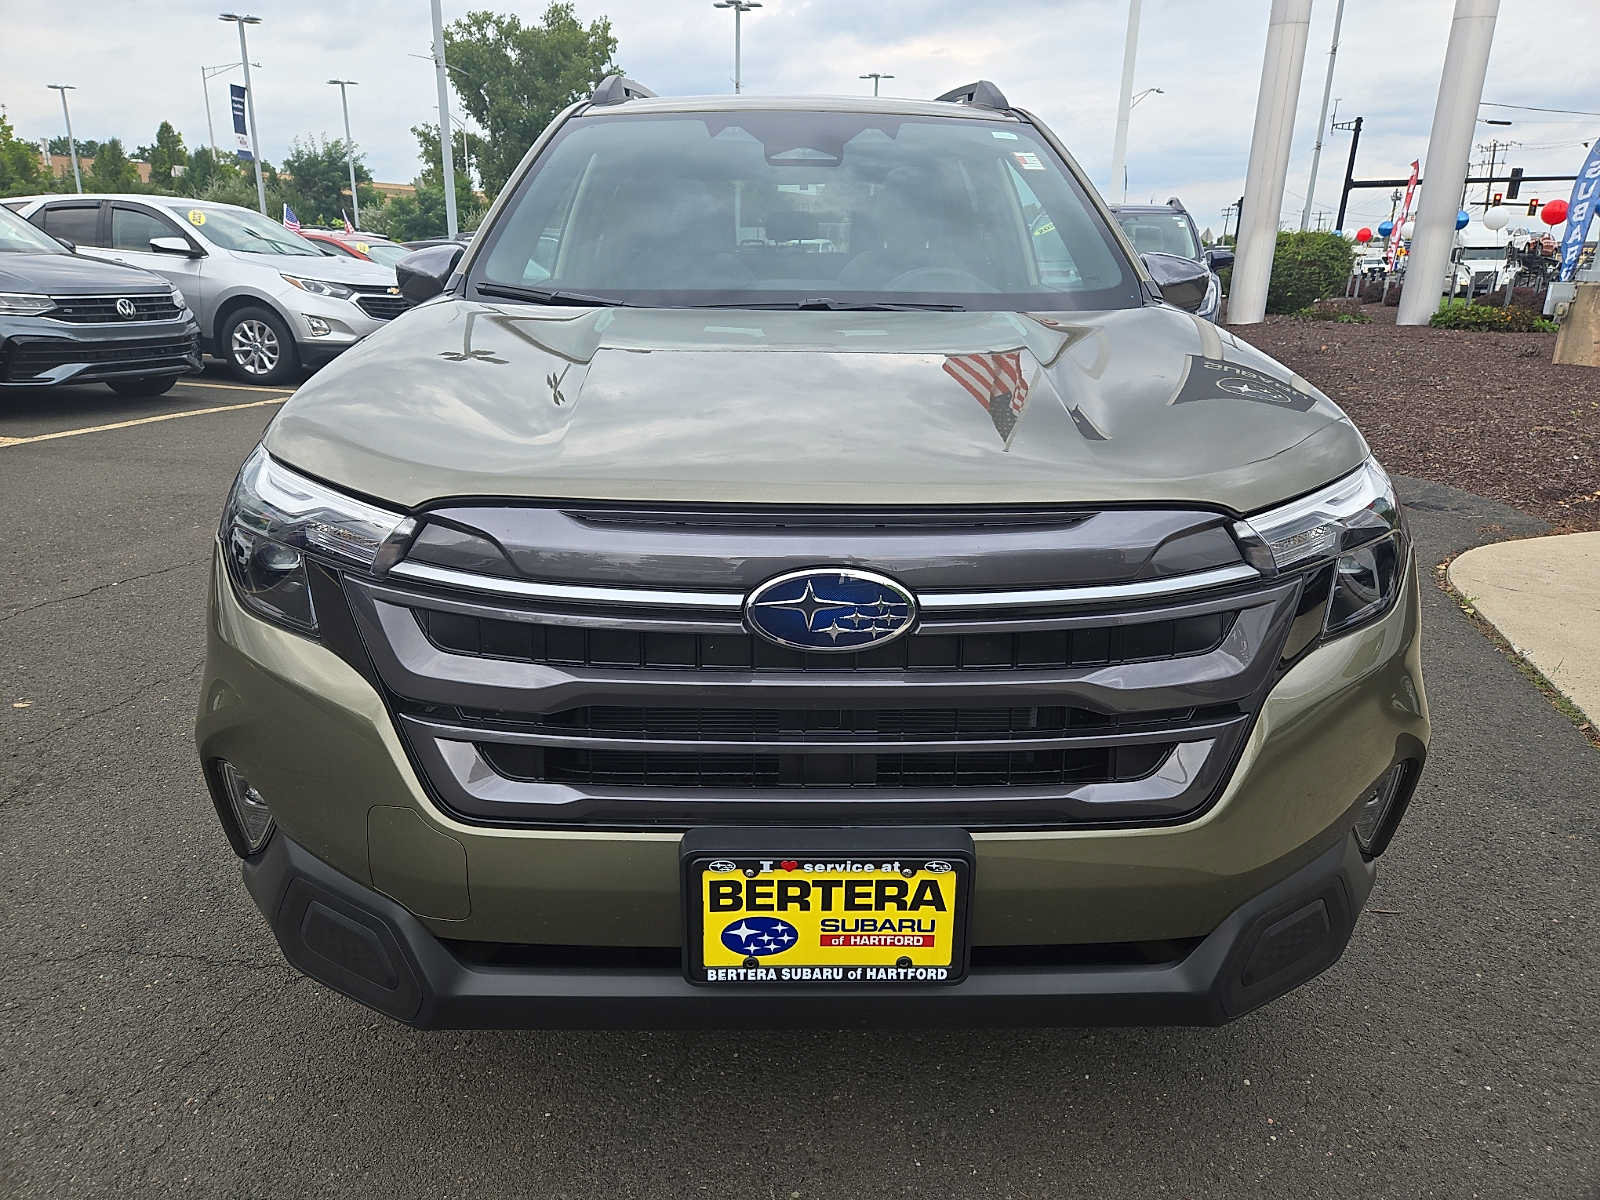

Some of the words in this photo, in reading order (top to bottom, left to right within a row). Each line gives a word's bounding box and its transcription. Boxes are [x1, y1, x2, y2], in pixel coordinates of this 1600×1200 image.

[760, 861, 773, 873] I
[803, 861, 875, 873] service
[881, 862, 900, 873] at
[708, 879, 947, 912] BERTERA
[820, 918, 936, 933] SUBARU
[831, 935, 844, 946] of
[850, 935, 924, 946] HARTFORD
[707, 968, 777, 981] BERTERA
[781, 968, 843, 980] SUBARU
[848, 967, 862, 980] of
[866, 967, 948, 980] HARTFORD
